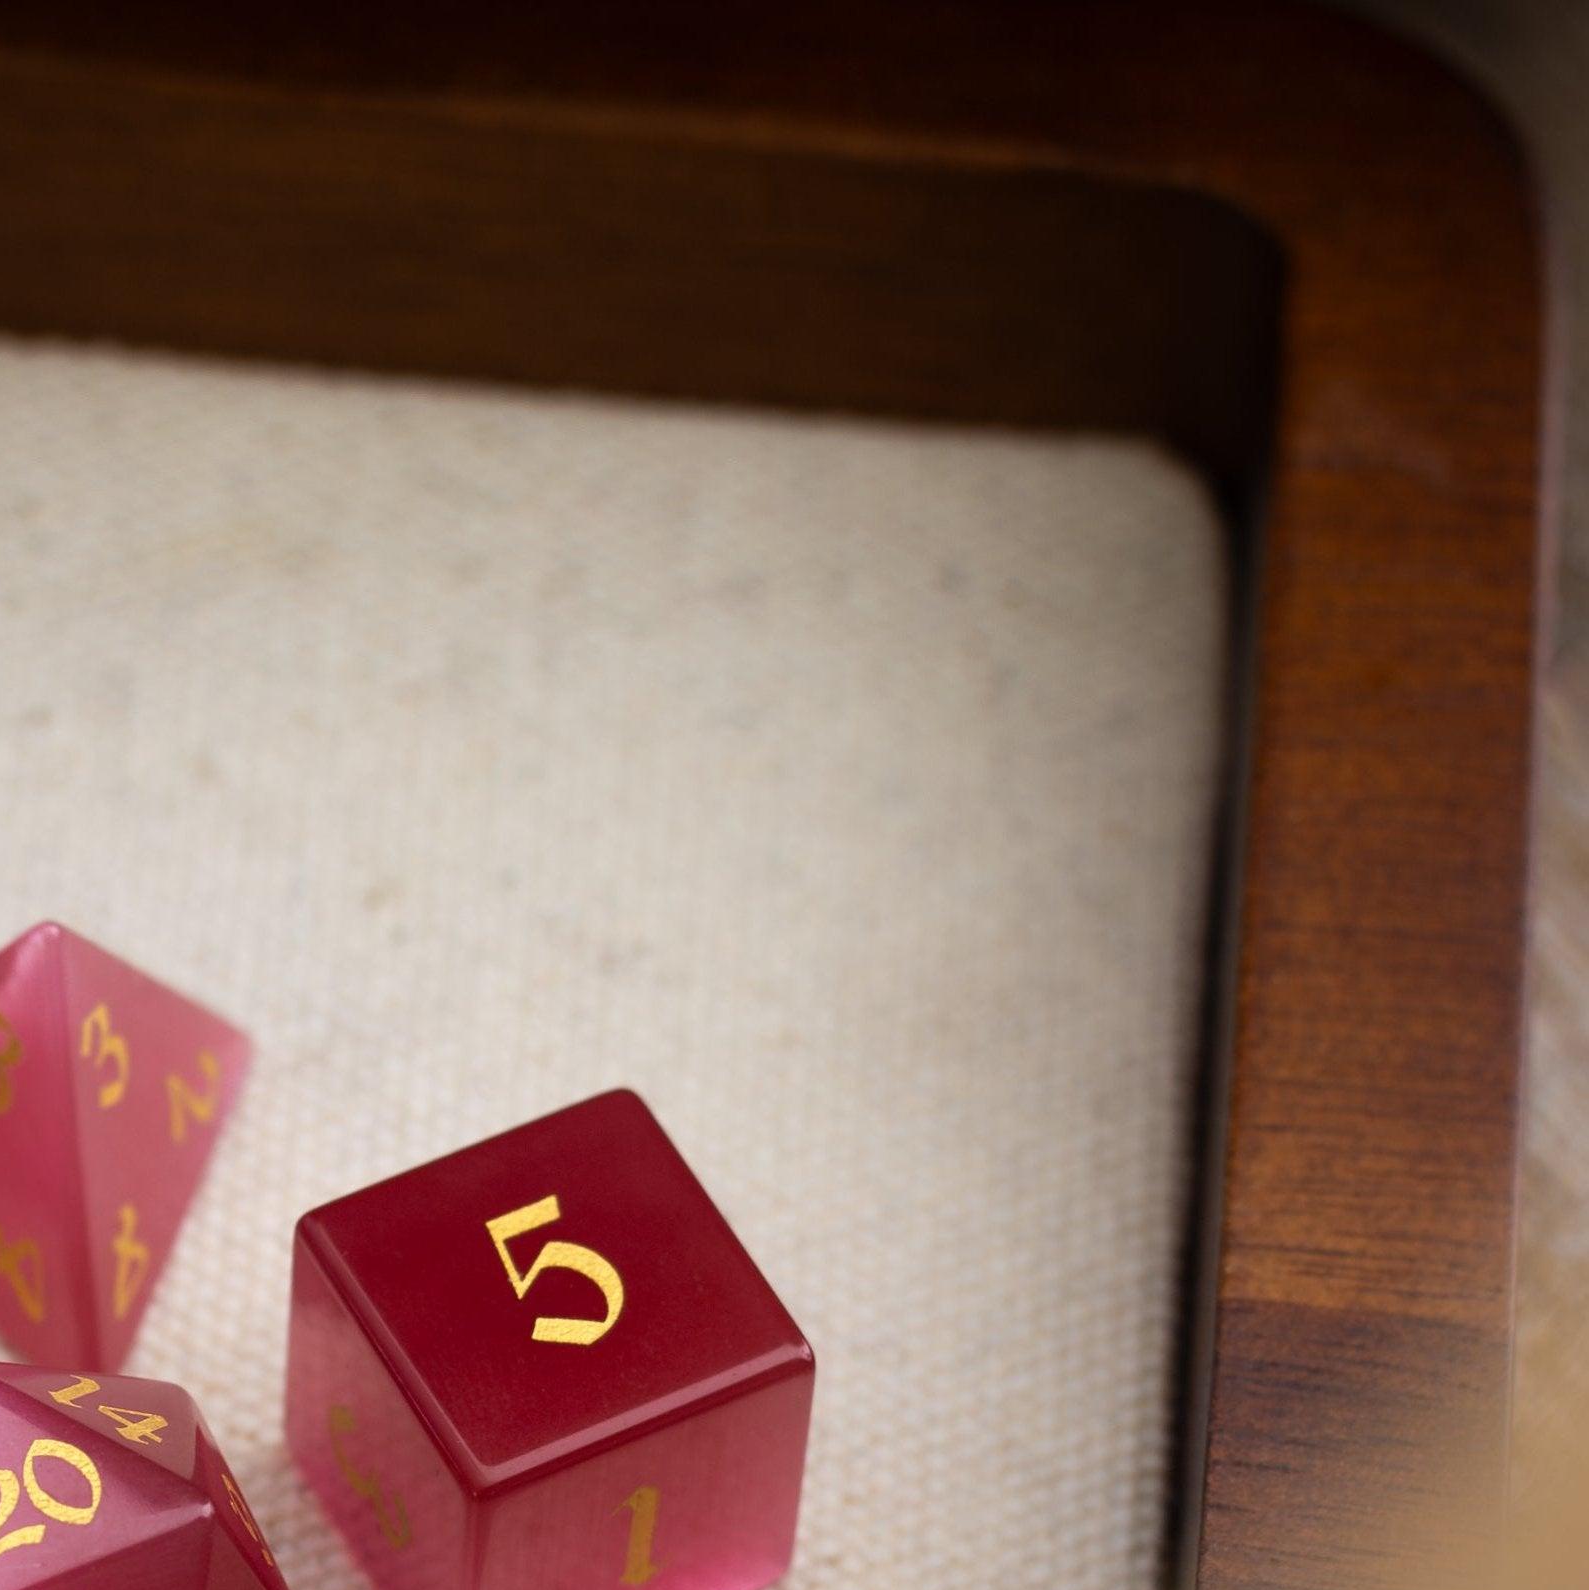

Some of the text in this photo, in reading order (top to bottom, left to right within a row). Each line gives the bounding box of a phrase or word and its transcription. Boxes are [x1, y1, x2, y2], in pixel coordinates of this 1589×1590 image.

[81, 1002, 128, 1108] 3
[165, 1048, 219, 1145] 2
[114, 1202, 149, 1320] 4
[485, 1194, 624, 1346] 5
[47, 1375, 170, 1445] 14
[612, 1486, 666, 1587] 1
